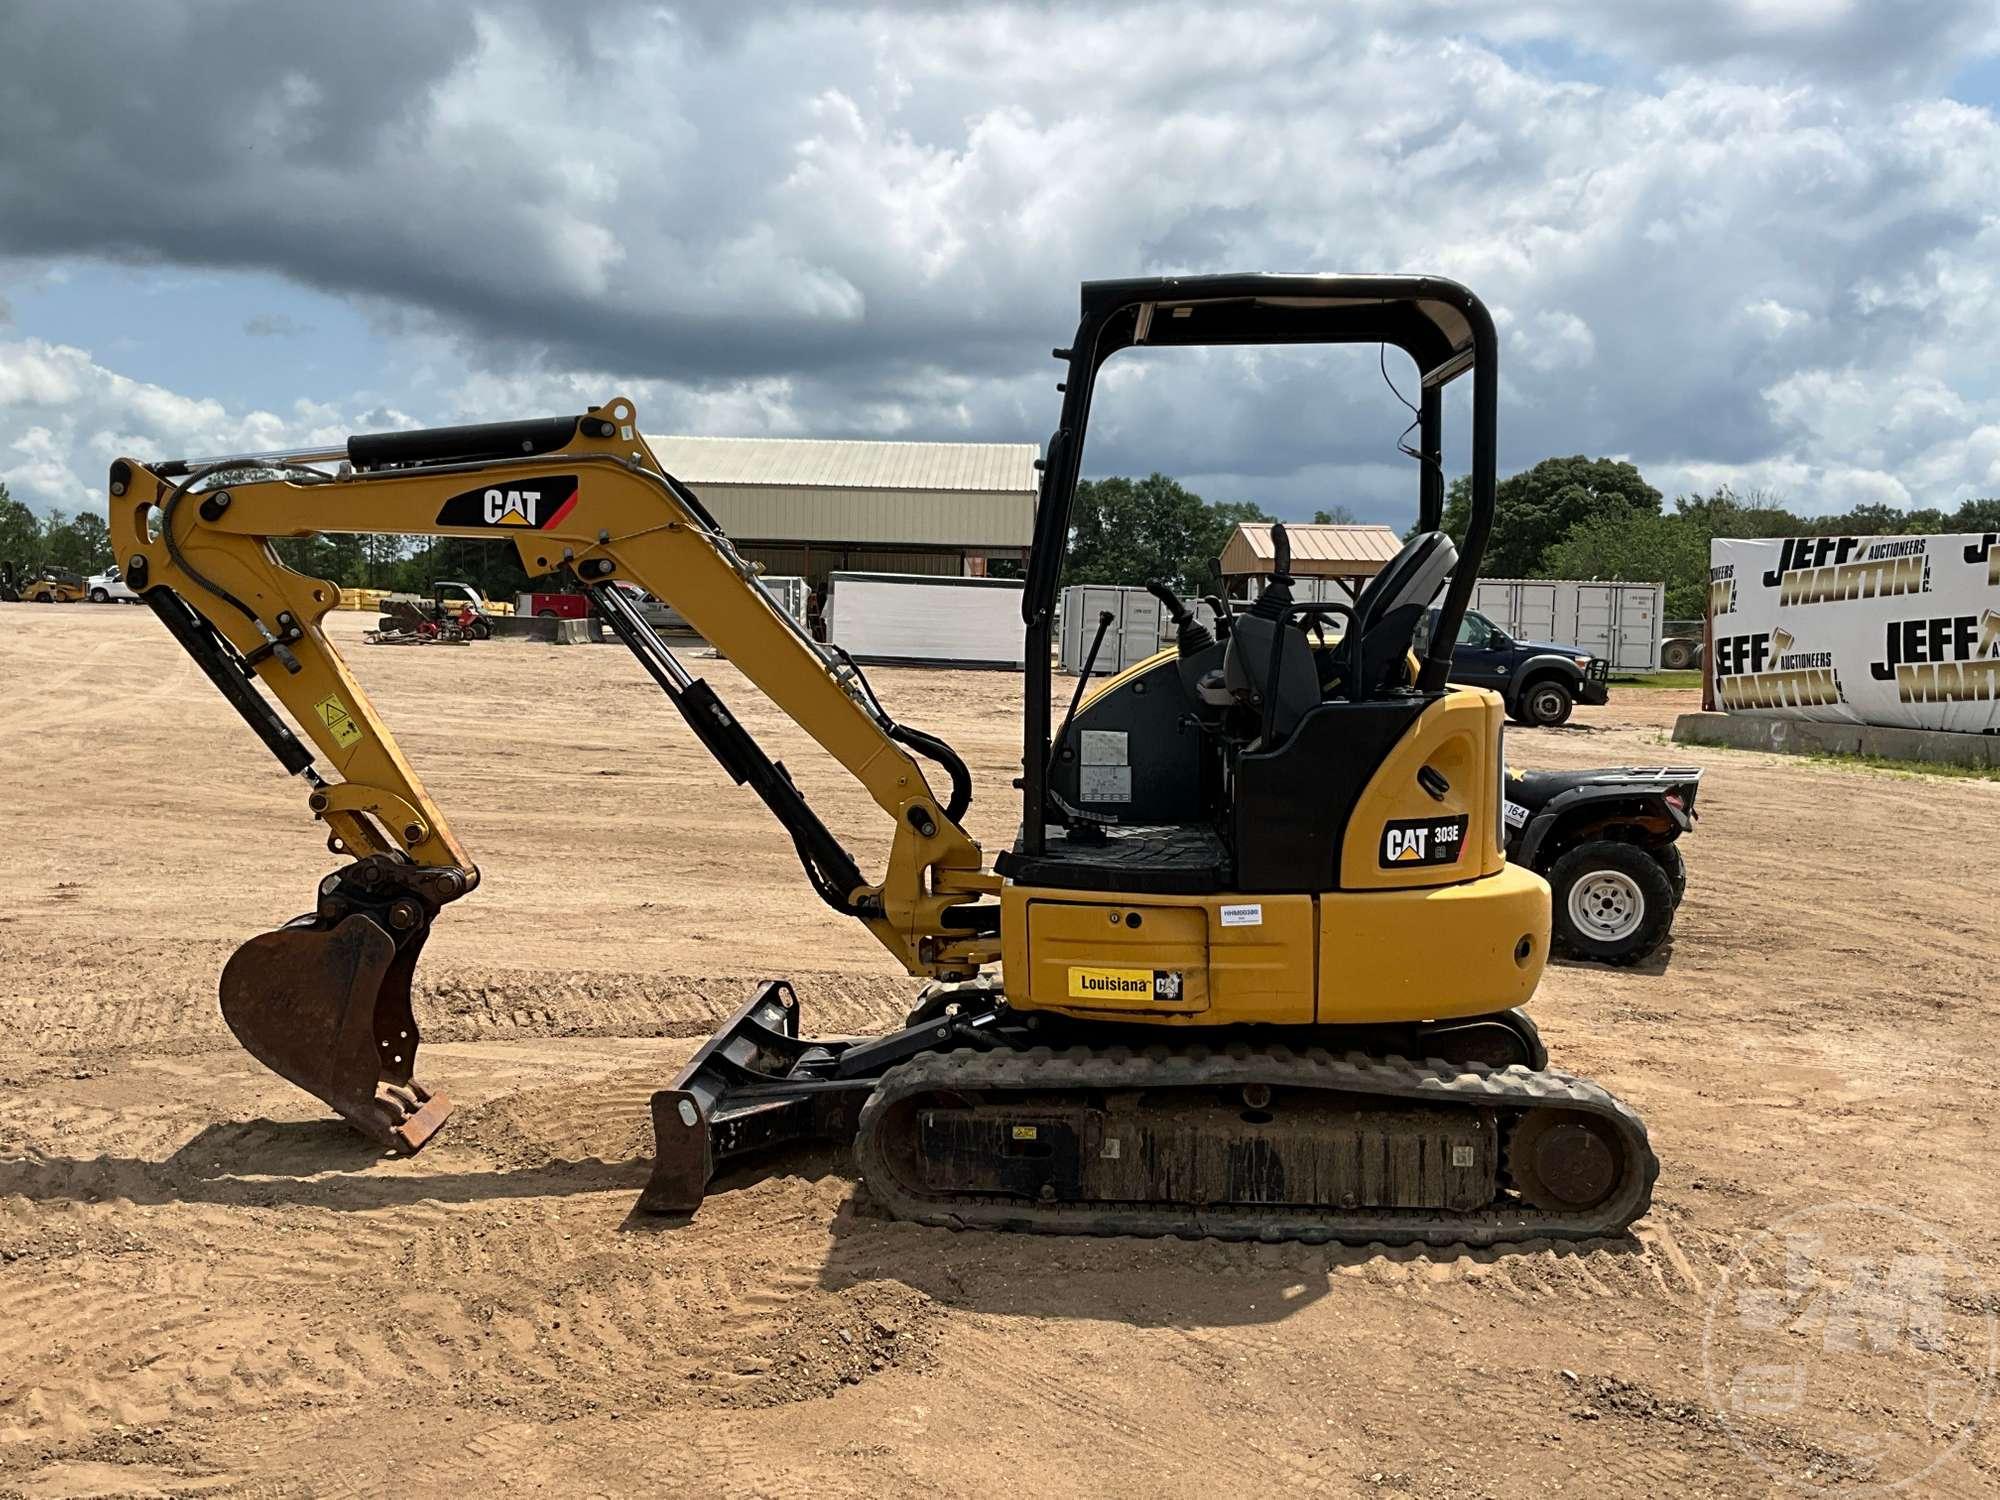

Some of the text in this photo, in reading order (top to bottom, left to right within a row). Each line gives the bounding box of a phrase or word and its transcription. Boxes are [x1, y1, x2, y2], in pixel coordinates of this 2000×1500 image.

[484, 489, 541, 526] CAT
[1868, 539, 1926, 560] AUCTIONEERS
[1780, 554, 1924, 608] MARTIN
[1780, 652, 1831, 670] AUCTIONEERS
[1870, 615, 1979, 681] JEFF
[1508, 804, 1526, 819] 164
[1387, 825, 1459, 862] CAT 303E
[1081, 975, 1147, 993] Louisiana
